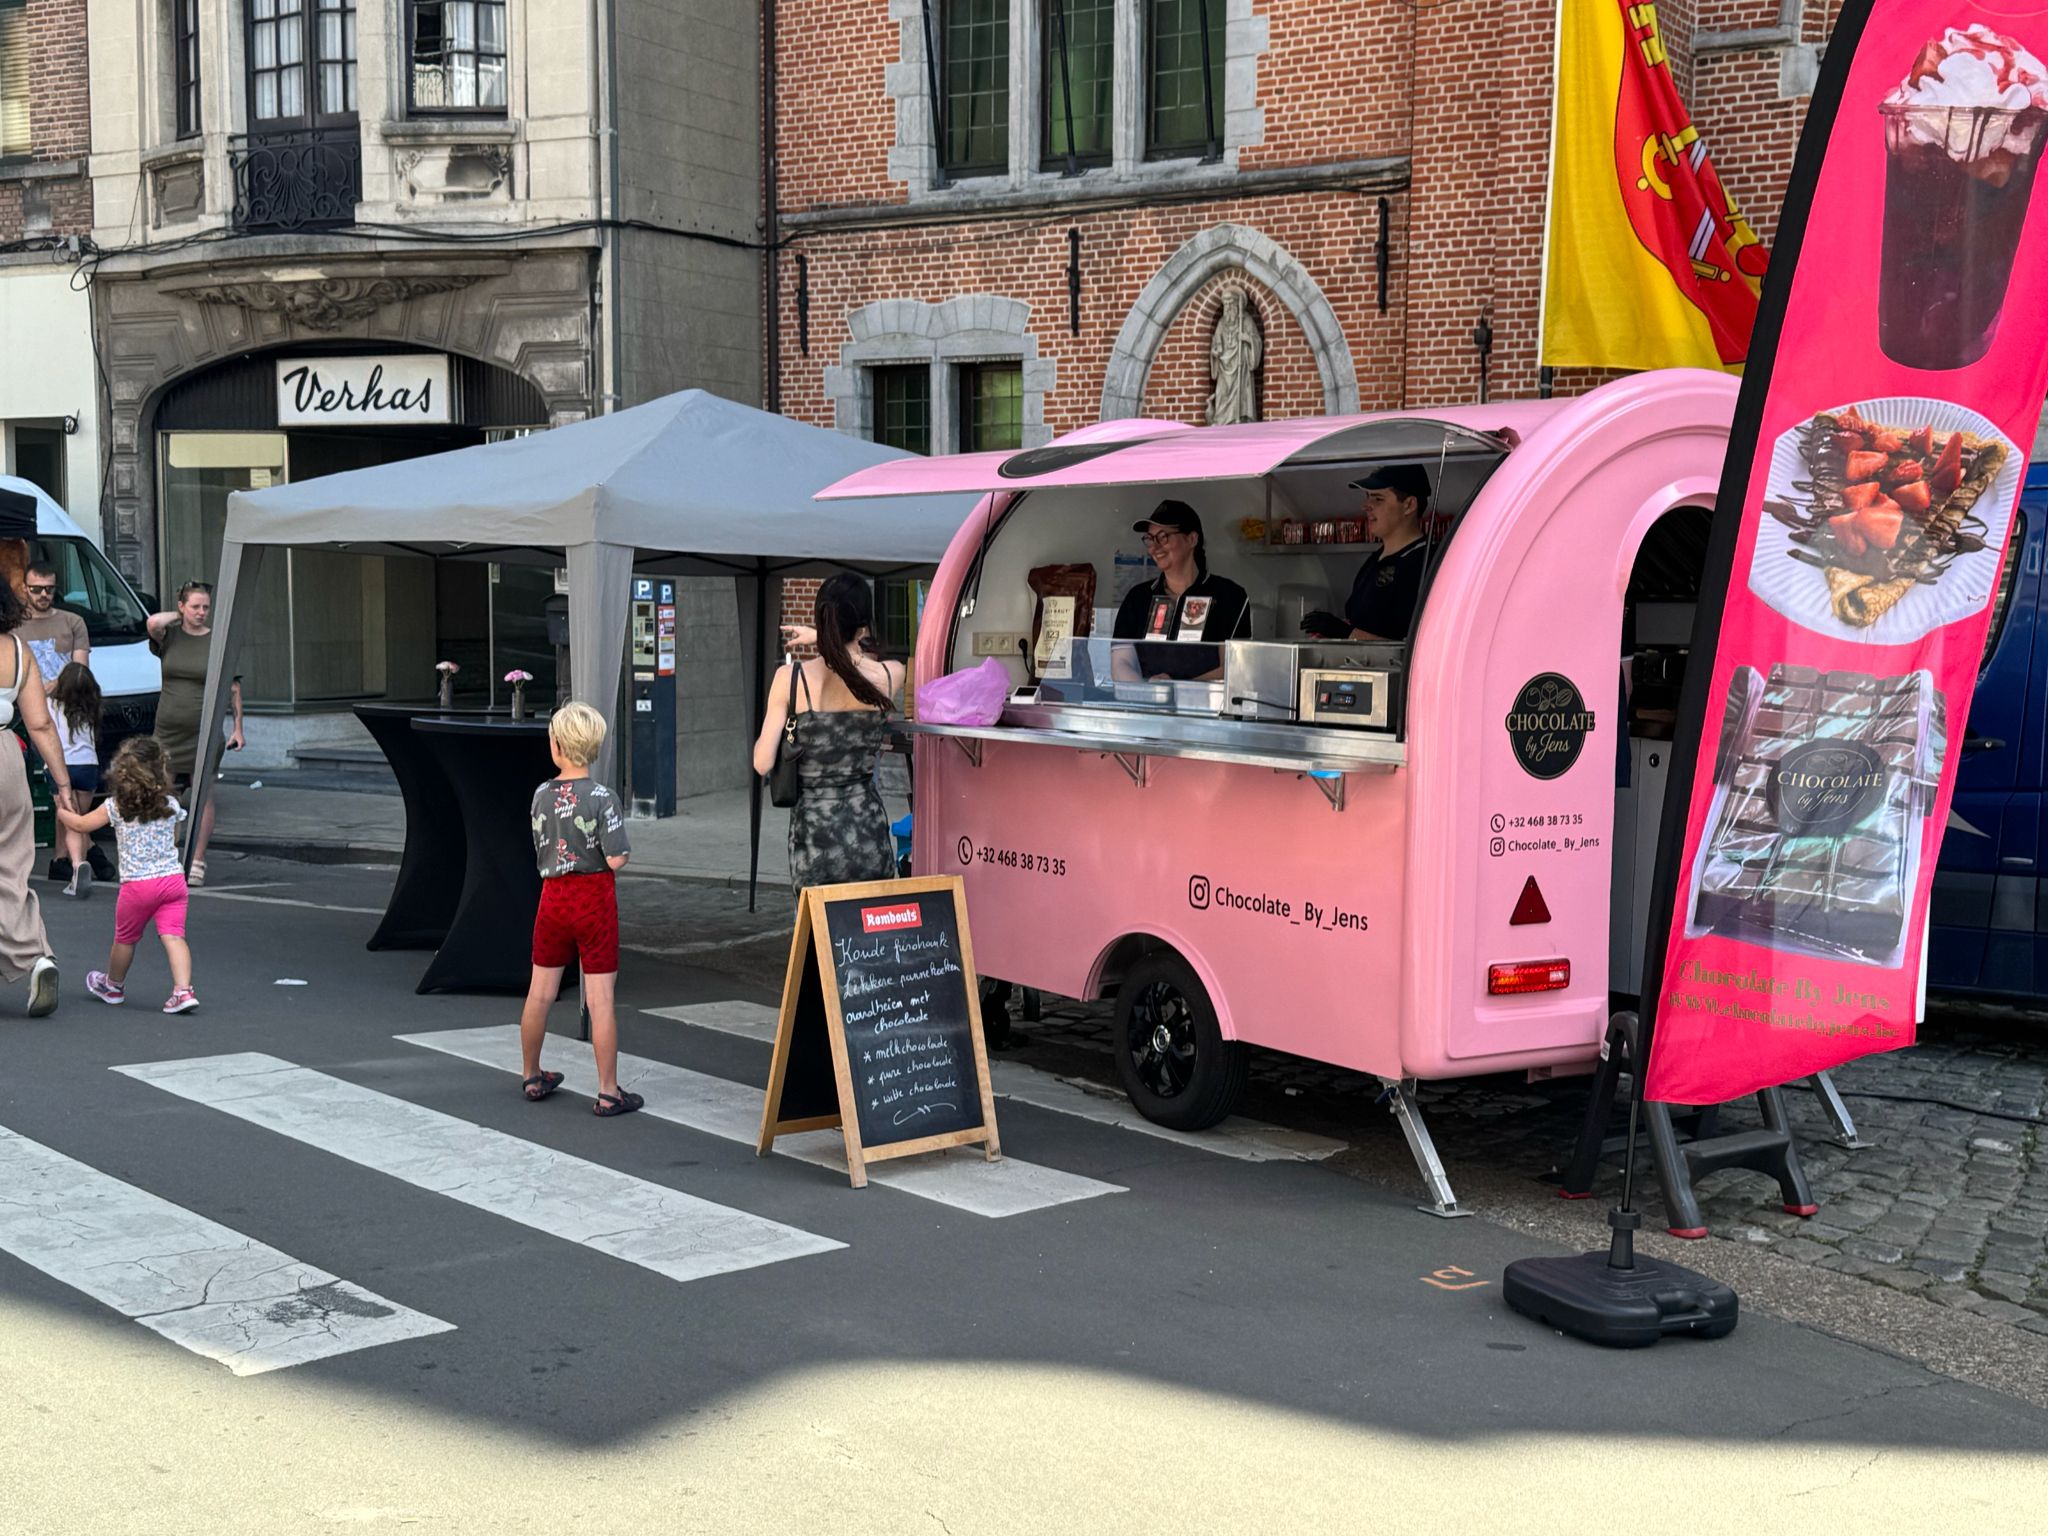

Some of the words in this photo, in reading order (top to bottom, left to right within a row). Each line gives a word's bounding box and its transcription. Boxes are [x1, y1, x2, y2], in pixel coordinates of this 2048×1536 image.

[283, 364, 432, 414] Verhas
[638, 580, 650, 596] P
[662, 584, 672, 600] P
[1506, 712, 1594, 731] CHOCOLATE
[1525, 735, 1537, 759] by
[1535, 733, 1569, 762] Jens
[1777, 770, 1884, 789] CHOCOLATE
[1797, 792, 1813, 809] by
[1807, 789, 1848, 812] Jens
[1508, 816, 1525, 828] +32
[1527, 815, 1545, 827] 468
[1547, 815, 1558, 826] 38
[1560, 814, 1570, 825] 73
[1572, 813, 1583, 824] 35
[1564, 836, 1600, 851] By_Jens
[976, 846, 995, 863] +32
[997, 849, 1018, 868] 468
[1020, 852, 1034, 870] 38
[1036, 856, 1049, 873] 73
[1052, 858, 1066, 876] 35
[866, 909, 918, 926] Rombouts
[1304, 902, 1368, 931] By_Jens
[835, 937, 885, 967] Koude
[1679, 960, 1789, 996] Chocolate
[1795, 977, 1821, 1008] By
[1832, 984, 1891, 1011] Jens
[846, 997, 903, 1024] aardbeien
[910, 990, 931, 1006] met
[874, 1009, 929, 1034] chocolade
[879, 1070, 902, 1087] pure
[907, 1054, 953, 1074] chocolade
[883, 1088, 904, 1104] witte
[909, 1076, 957, 1096] chocolade
